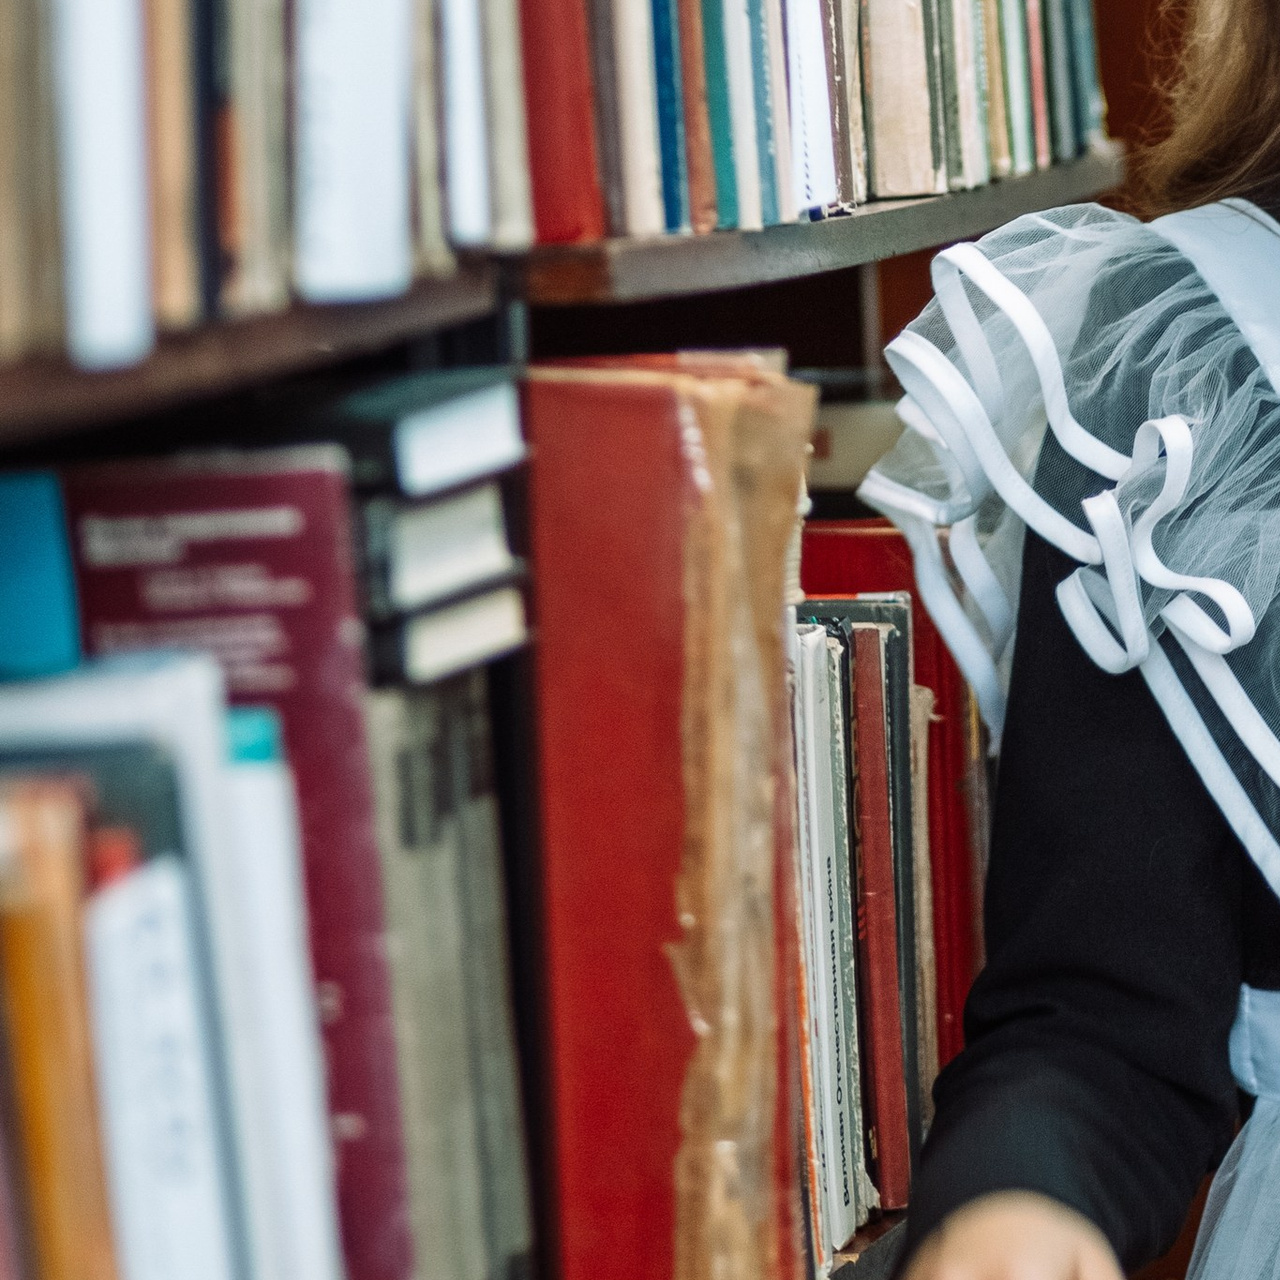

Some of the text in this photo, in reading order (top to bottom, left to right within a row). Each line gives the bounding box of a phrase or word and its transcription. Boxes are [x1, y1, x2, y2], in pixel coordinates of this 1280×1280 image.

[825, 855, 850, 1207] Великая Отечественная война
